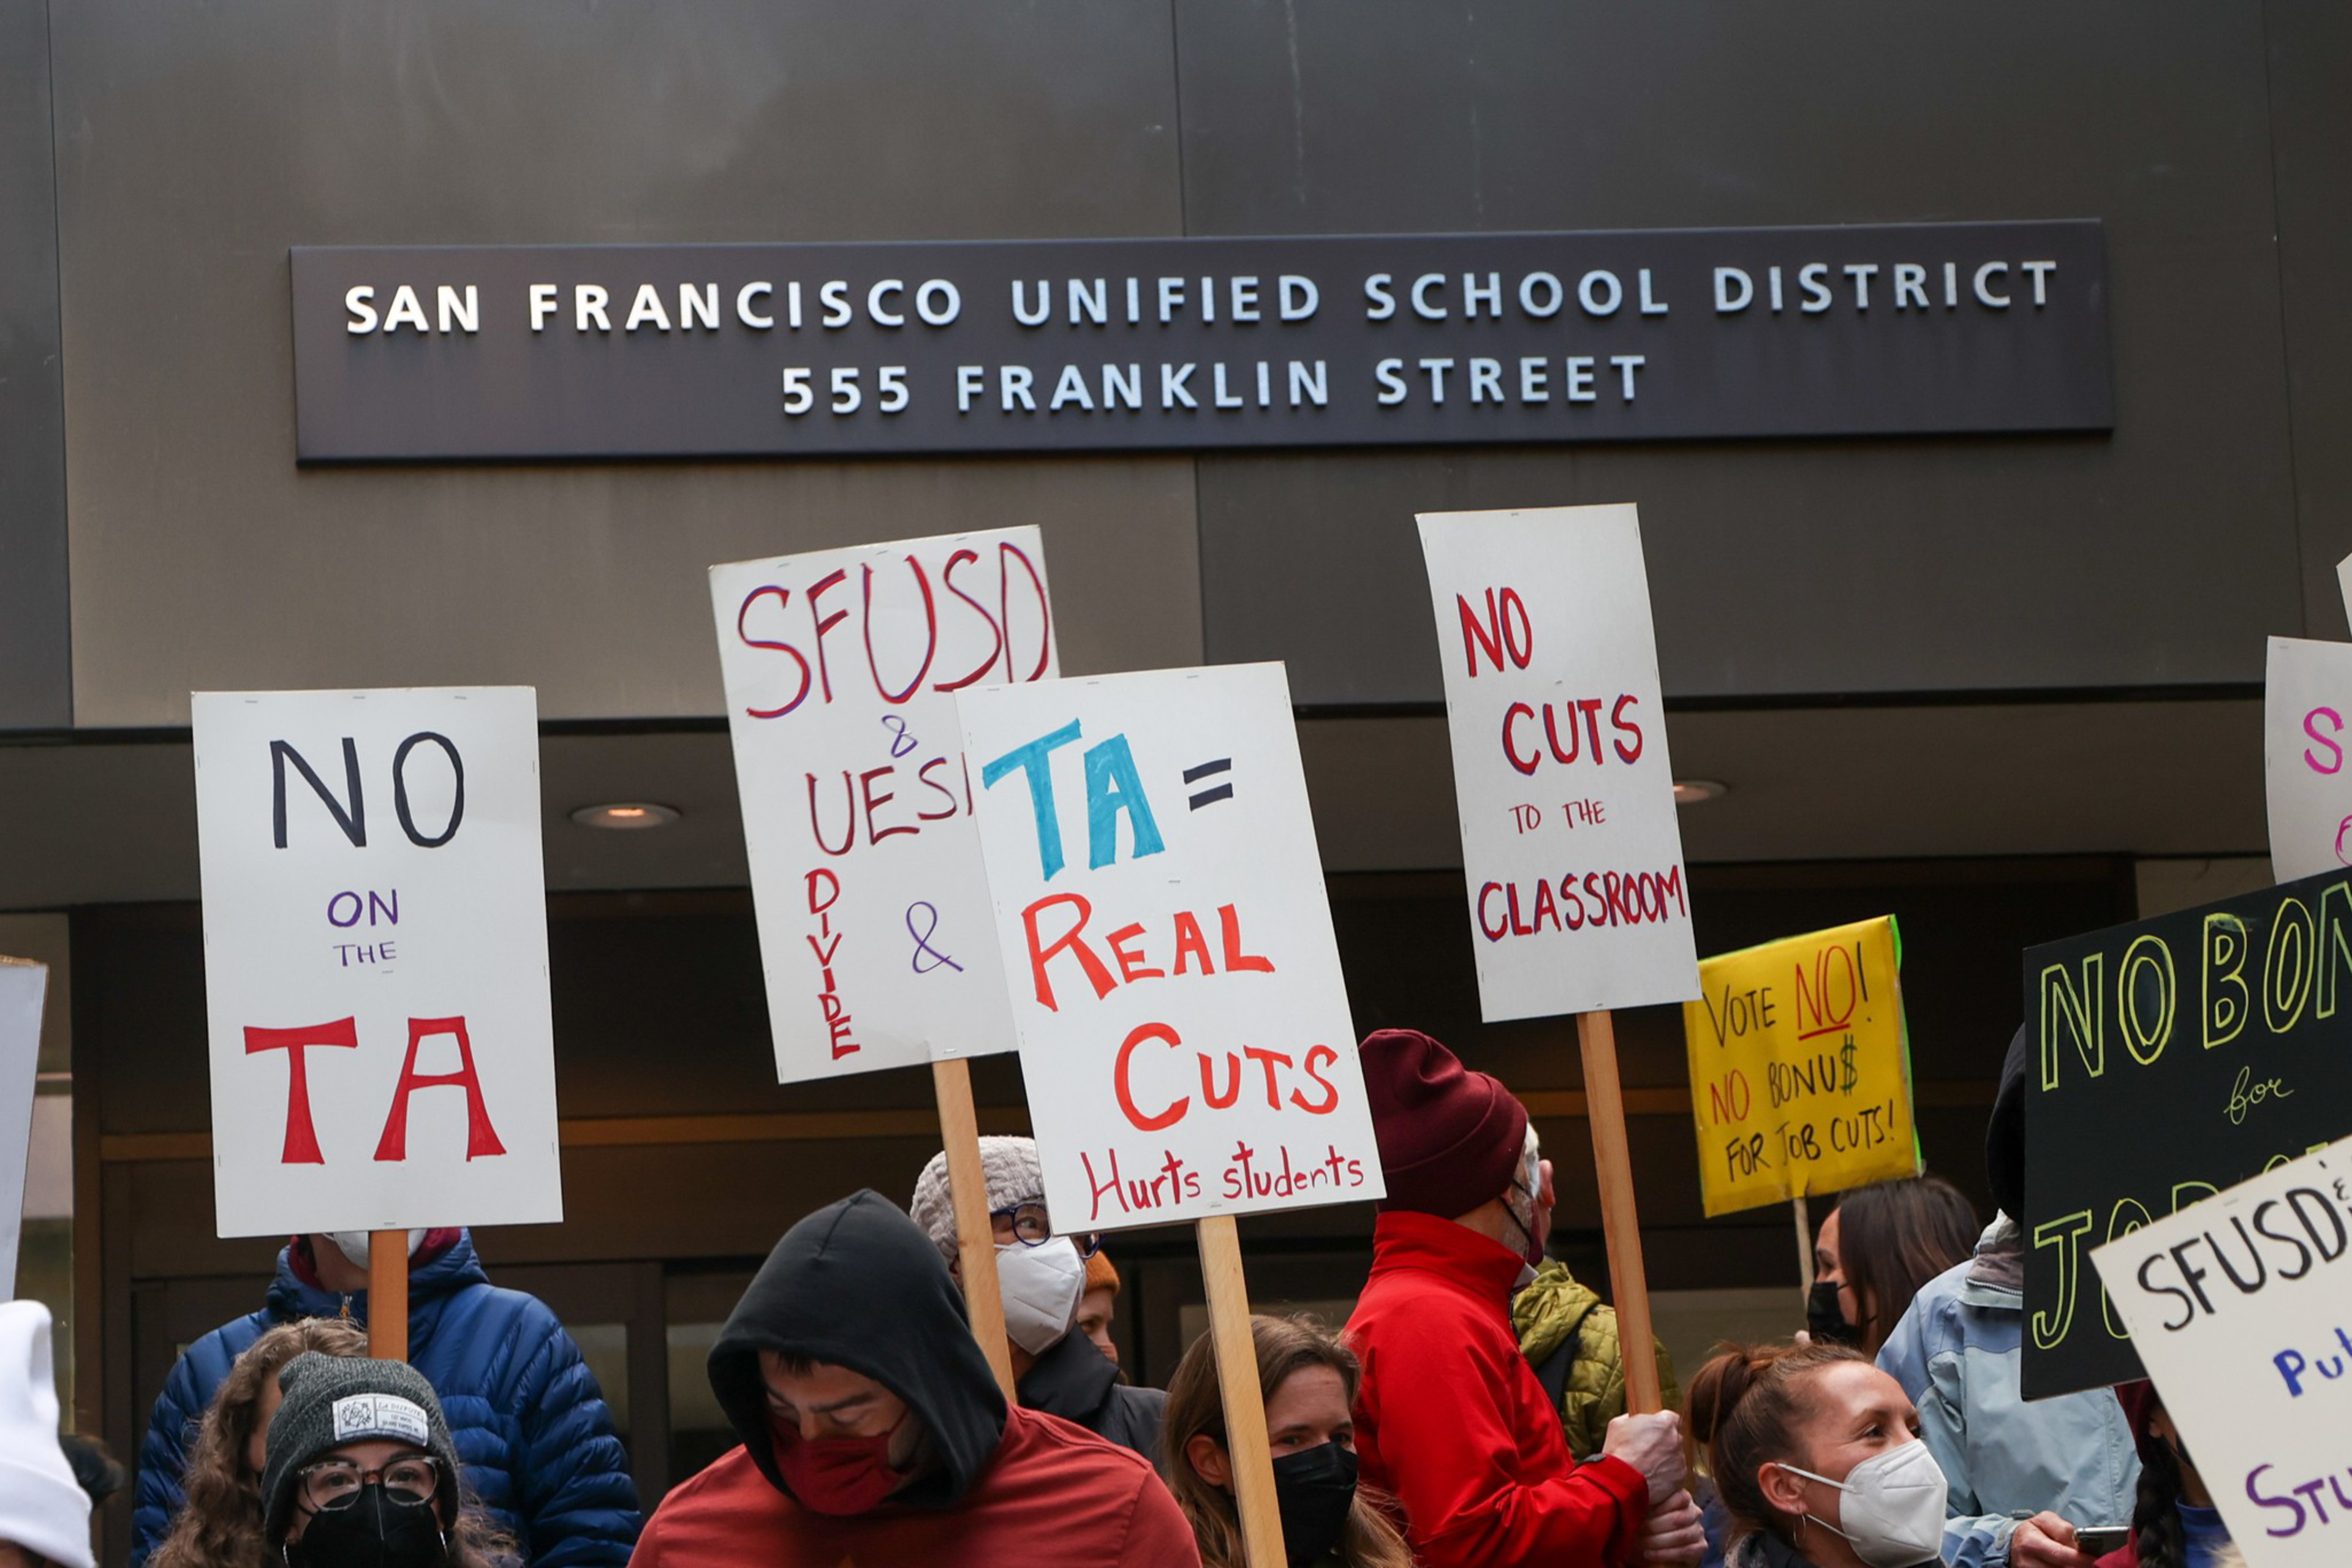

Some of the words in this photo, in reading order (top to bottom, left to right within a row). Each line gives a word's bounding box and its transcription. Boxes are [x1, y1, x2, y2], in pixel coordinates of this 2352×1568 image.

[346, 284, 480, 334] SAN
[529, 279, 961, 331] FRANCISCO
[1011, 275, 1320, 325] UNIFIED
[1364, 269, 1669, 319] SCHOOL
[1714, 261, 2057, 312] DISTRICT
[782, 366, 910, 414] 555
[957, 361, 1328, 411] FRANKLIN
[1375, 355, 1646, 404] STREET
[738, 541, 1049, 718] SFUSD
[1456, 586, 1533, 678] NO
[1502, 693, 1643, 776] CUTS
[270, 731, 464, 850] NO
[804, 752, 974, 856] UES
[981, 717, 1166, 882] TA
[1508, 801, 1542, 835] TO
[1562, 798, 1606, 828] THE
[327, 889, 399, 927] ON
[905, 900, 964, 973] &
[1477, 865, 1686, 942] CLASSROOM
[333, 941, 397, 967] THE
[804, 867, 861, 1061] DIVIDE
[1020, 892, 1276, 1012] REAL
[1702, 984, 1777, 1048] VOTE
[1795, 941, 1872, 1032] NO!
[2040, 935, 2177, 1092] NO
[243, 1015, 507, 1165] TA
[1114, 1022, 1339, 1132] CUTS
[1710, 1069, 1750, 1125] NO
[1768, 1033, 1858, 1109] BONU$
[2223, 1066, 2295, 1125] for
[1080, 1147, 1201, 1221] Hurts
[1222, 1140, 1364, 1199] students
[1725, 1132, 1771, 1183] FOR
[1776, 1121, 1821, 1166] JOB
[1830, 1098, 1896, 1153] CUTS!
[2136, 1188, 2348, 1332] SFUSD
